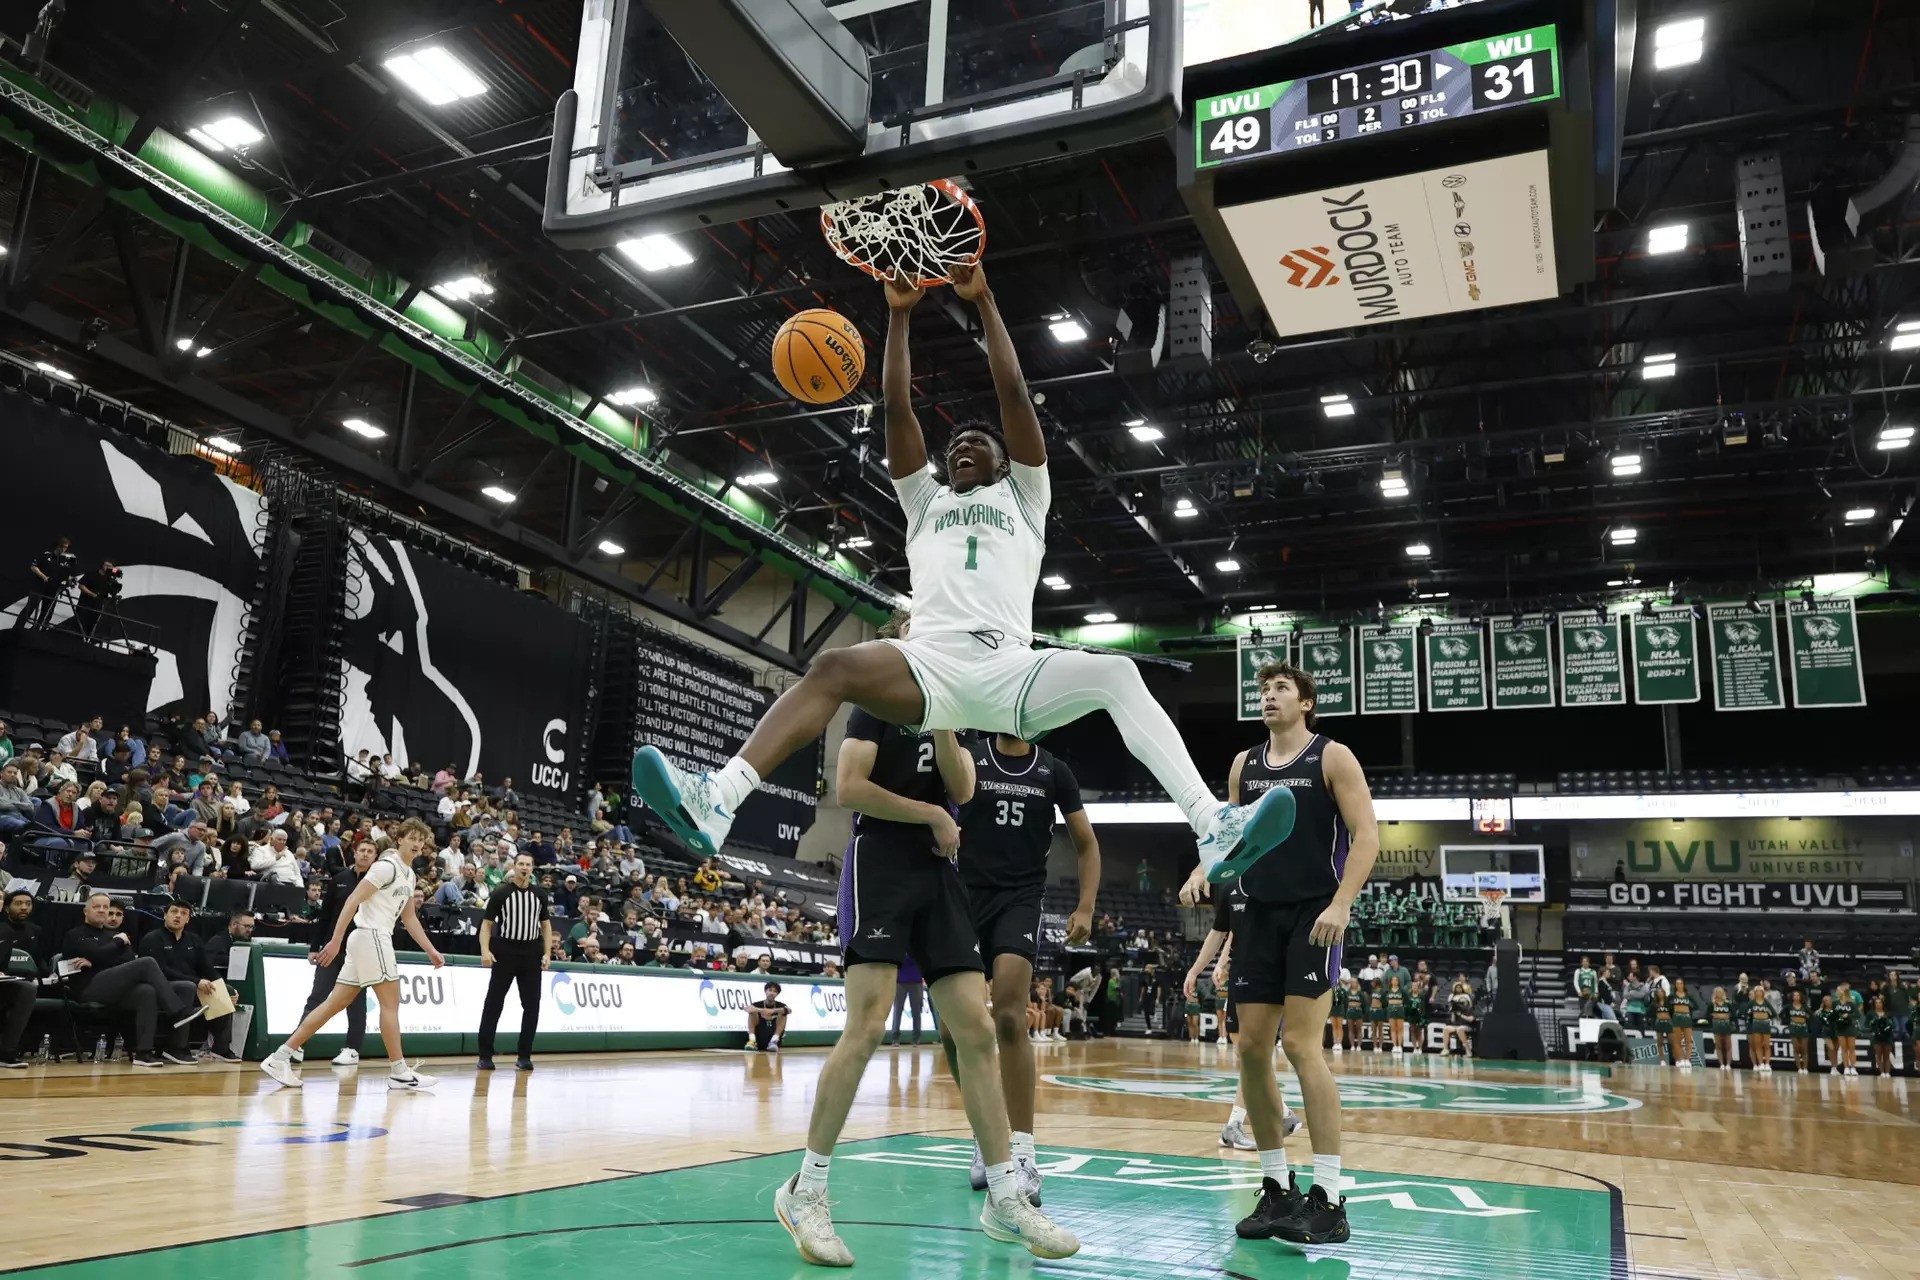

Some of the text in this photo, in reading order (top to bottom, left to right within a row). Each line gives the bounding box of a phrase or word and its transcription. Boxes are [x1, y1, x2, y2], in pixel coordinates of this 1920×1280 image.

[1486, 33, 1533, 60] WU
[1332, 59, 1421, 105] 17:30
[1484, 58, 1535, 100] 31
[1210, 91, 1260, 117] UVU
[1420, 92, 1446, 106] FLS
[1364, 107, 1376, 121] 2
[1404, 107, 1448, 124] 3 TOL
[1358, 121, 1382, 133] PER
[1210, 116, 1260, 154] 49
[1294, 129, 1335, 145] TOL 3
[1322, 188, 1400, 320] MURDOCK
[1384, 223, 1414, 286] AUTO TEAM
[1462, 260, 1477, 282] GMC
[934, 504, 1015, 536] WOLVERINES
[964, 535, 978, 570] 1
[1816, 601, 1849, 610] VALLEY
[1728, 644, 1761, 654] NJCAA
[1796, 646, 1854, 656] ALL-AMERICANS
[1810, 640, 1839, 648] NCAA
[638, 646, 665, 665] STAND
[664, 654, 676, 668] UP
[676, 660, 692, 674] AND
[1566, 652, 1592, 660] GREAT
[1650, 650, 1680, 659] NCAA
[1718, 650, 1773, 660] ALL-AMERICANS
[1374, 663, 1404, 672] SWAC
[1433, 660, 1466, 669] REGION
[1497, 664, 1547, 672] INDEPENDENT
[1566, 658, 1617, 667] TOURNAMENT
[1566, 664, 1618, 674] CHAMPIONS
[1640, 658, 1692, 667] TOURNAMENT
[1312, 668, 1342, 678] NJCAA
[1365, 671, 1413, 680] CHAMPIONS
[1432, 668, 1480, 676] CHAMPIONS
[1497, 670, 1548, 680] CHAMPIONS
[1582, 674, 1604, 682] 2010
[1646, 669, 1686, 678] 2020-21
[1329, 676, 1352, 685] FOUR
[652, 668, 668, 682] ARE
[669, 671, 684, 688] THE
[684, 676, 710, 697] PROUD
[710, 687, 752, 712] WOLVERINES
[1498, 685, 1548, 696] 2008-09
[1567, 686, 1620, 695] CHAMPIONS
[669, 688, 678, 701] IN
[679, 692, 706, 712] BATTLE
[706, 701, 722, 718] TILL
[722, 707, 736, 722] THE
[736, 712, 755, 729] GAME
[654, 700, 669, 716] THE
[670, 704, 701, 724] VICTORY
[702, 716, 713, 730] WE
[714, 720, 732, 738] HAVE
[635, 713, 724, 750] STAND UP AND SING UVU
[652, 733, 673, 750] SONG
[674, 740, 692, 756] WILL
[693, 744, 710, 761] RING
[531, 762, 569, 792] UCCU
[978, 780, 1046, 798] WESTMINSTER
[995, 800, 1025, 827] 35
[1626, 838, 1862, 874] UVU UTAH VALLEY
[1748, 860, 1864, 874] UNIVERSITY
[1610, 883, 1859, 906] GO FIGHT UVU
[574, 982, 622, 1008] UCCU
